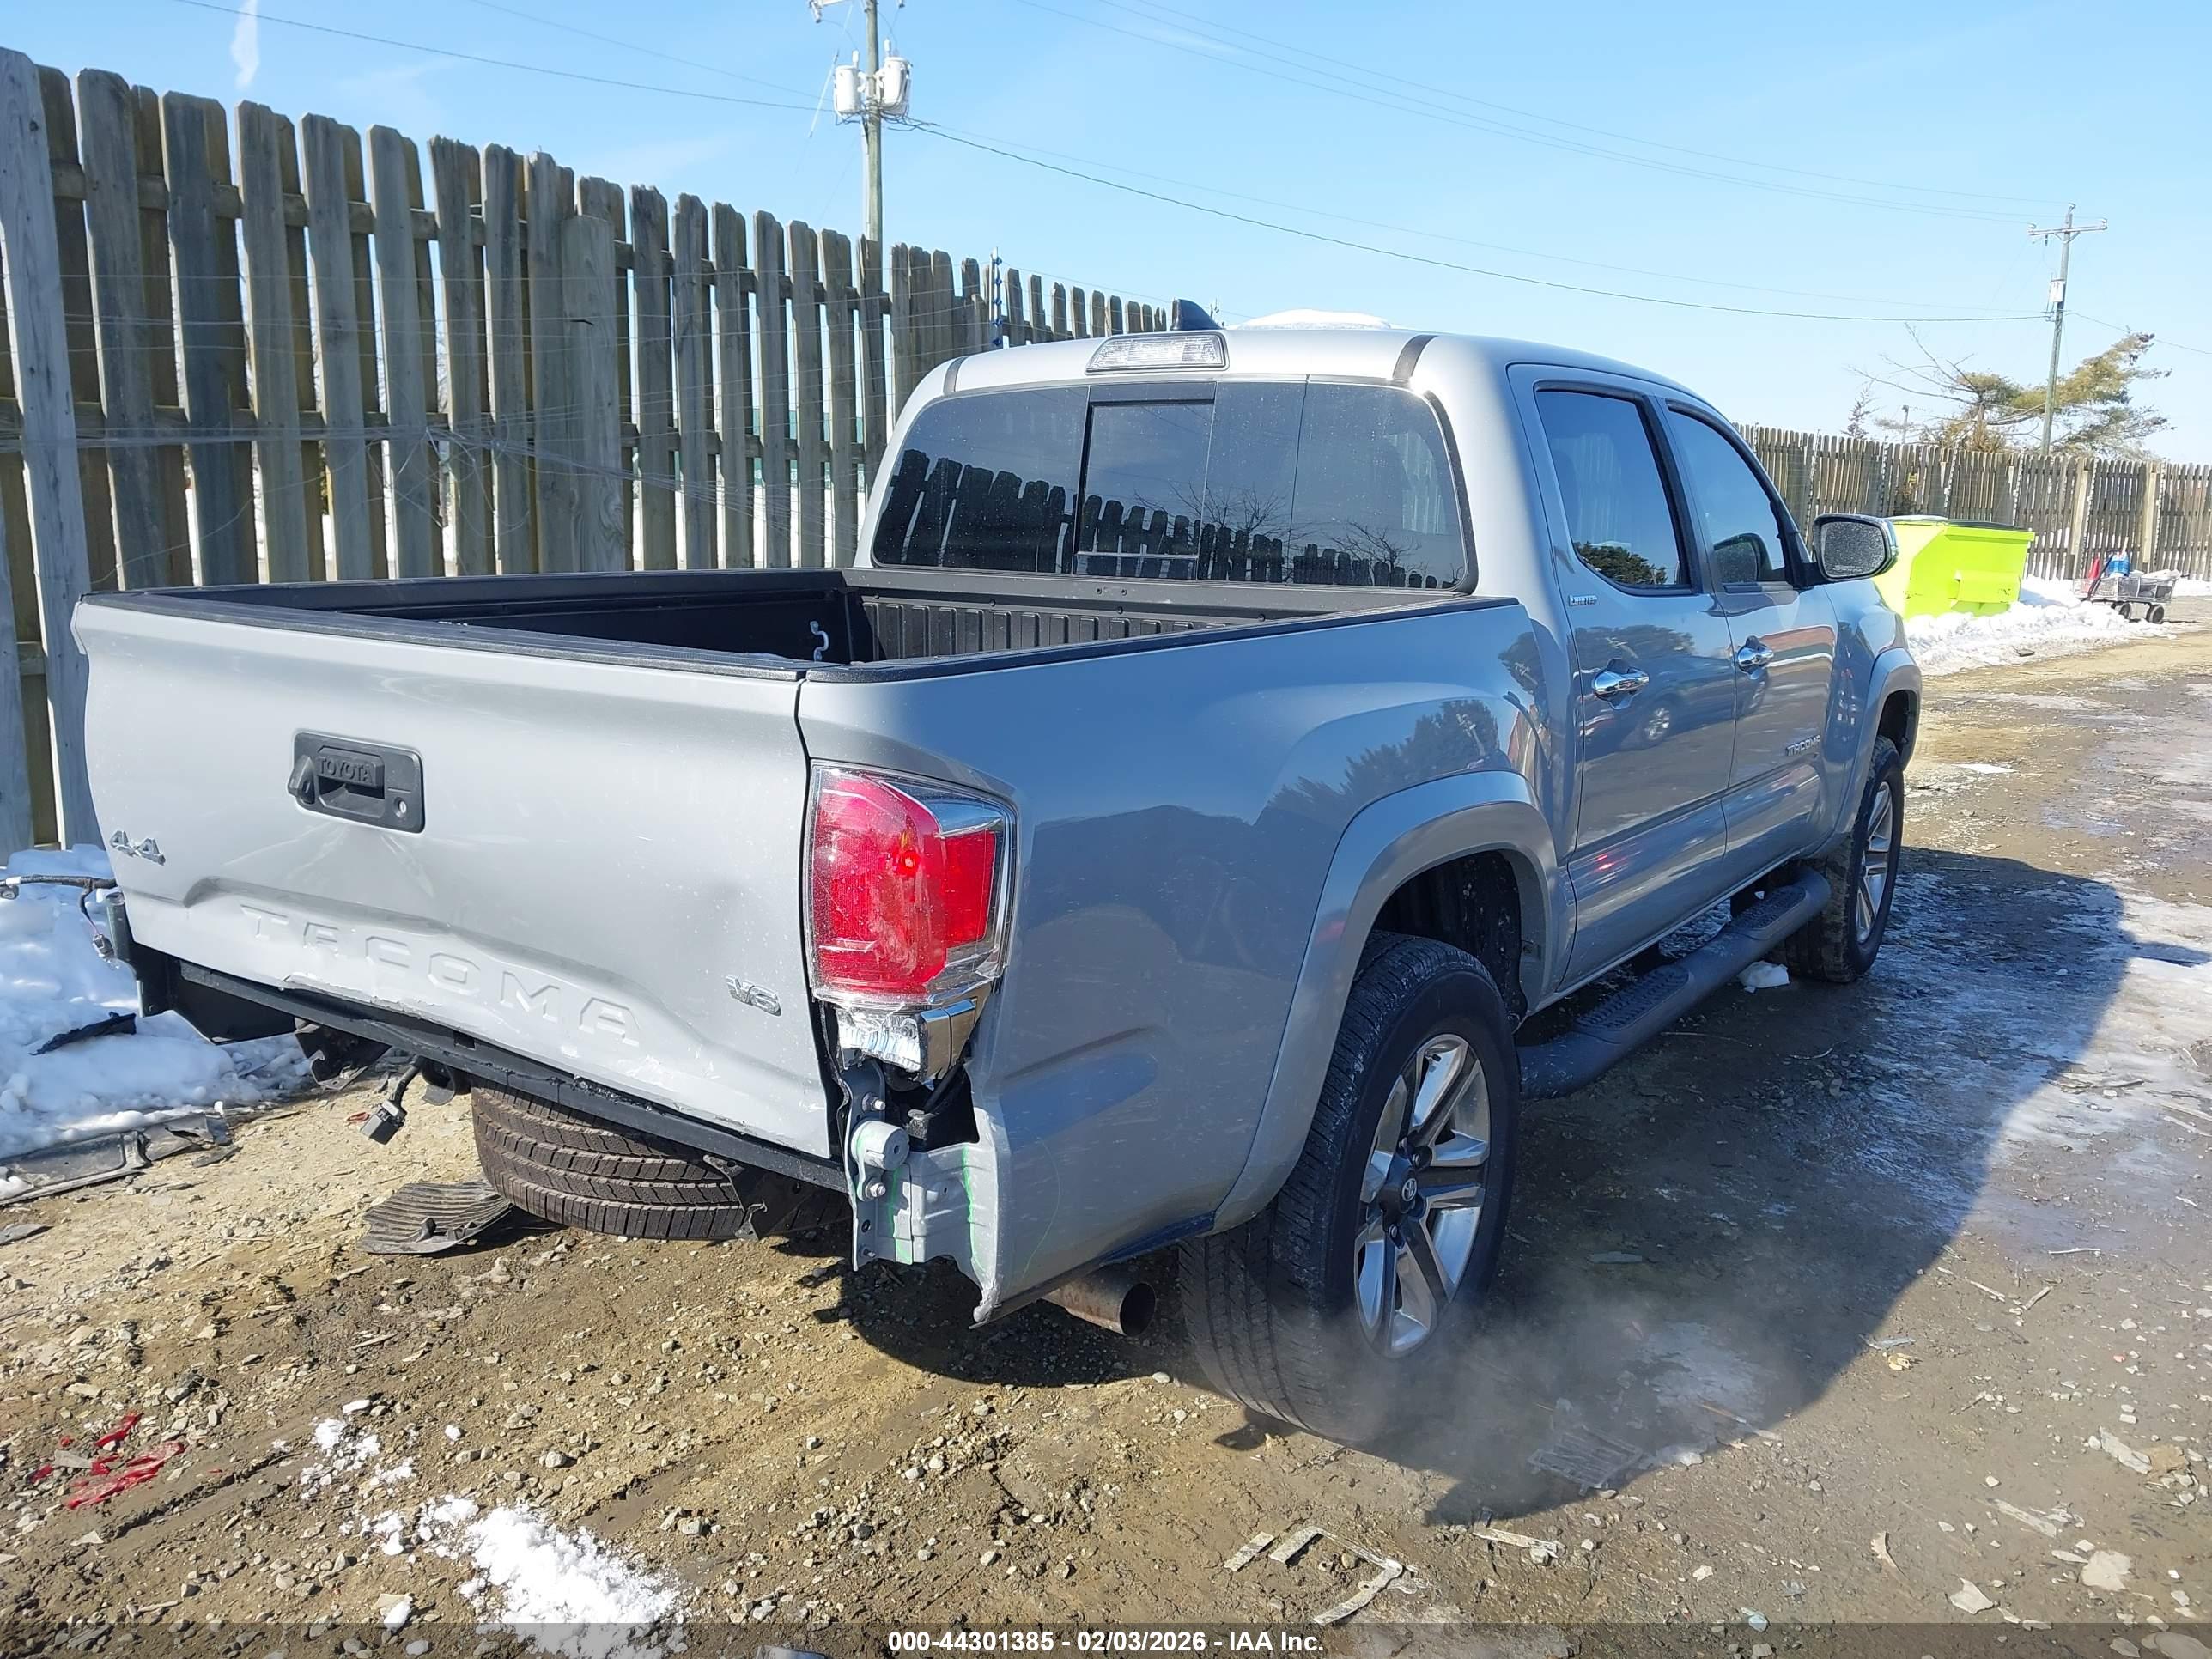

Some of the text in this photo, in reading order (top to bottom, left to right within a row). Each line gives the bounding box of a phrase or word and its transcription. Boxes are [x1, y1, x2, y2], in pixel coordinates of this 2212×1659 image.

[1786, 734, 1820, 757] TACOMA
[317, 757, 374, 784] TOYOTA
[240, 903, 641, 1047] TACOMA
[726, 975, 781, 1017] V6
